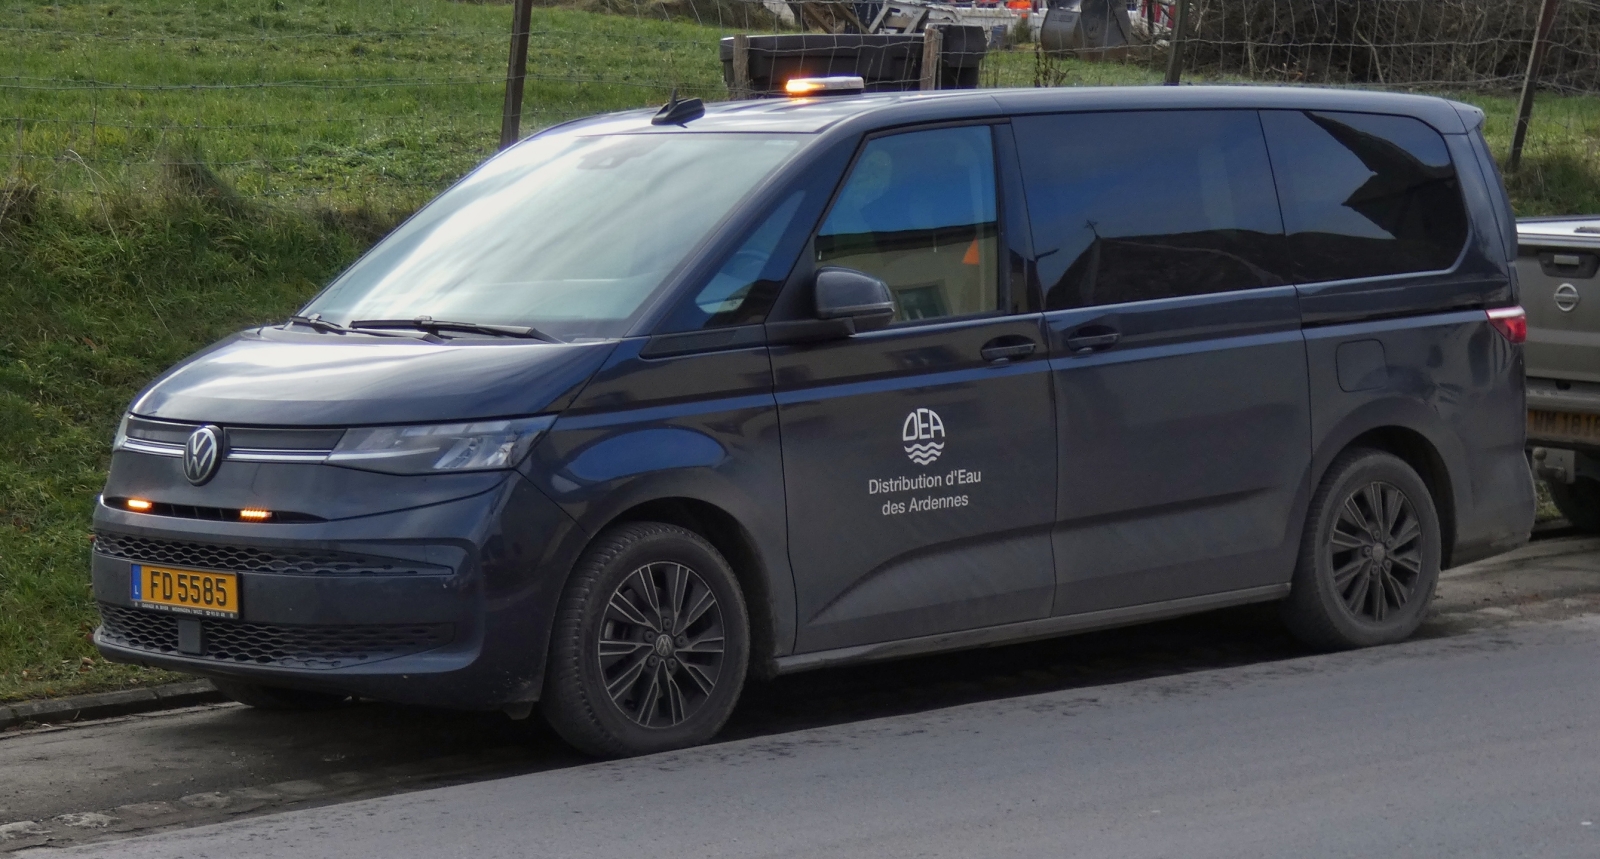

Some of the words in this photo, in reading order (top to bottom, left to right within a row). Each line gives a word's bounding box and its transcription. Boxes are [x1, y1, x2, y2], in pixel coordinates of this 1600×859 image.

[902, 407, 946, 441] DEA
[868, 474, 942, 495] Distribution
[945, 469, 982, 486] d'Eau
[882, 500, 906, 516] des
[908, 494, 969, 513] Ardennes
[134, 584, 139, 595] L
[150, 570, 173, 600] FD
[177, 573, 227, 607] 5585
